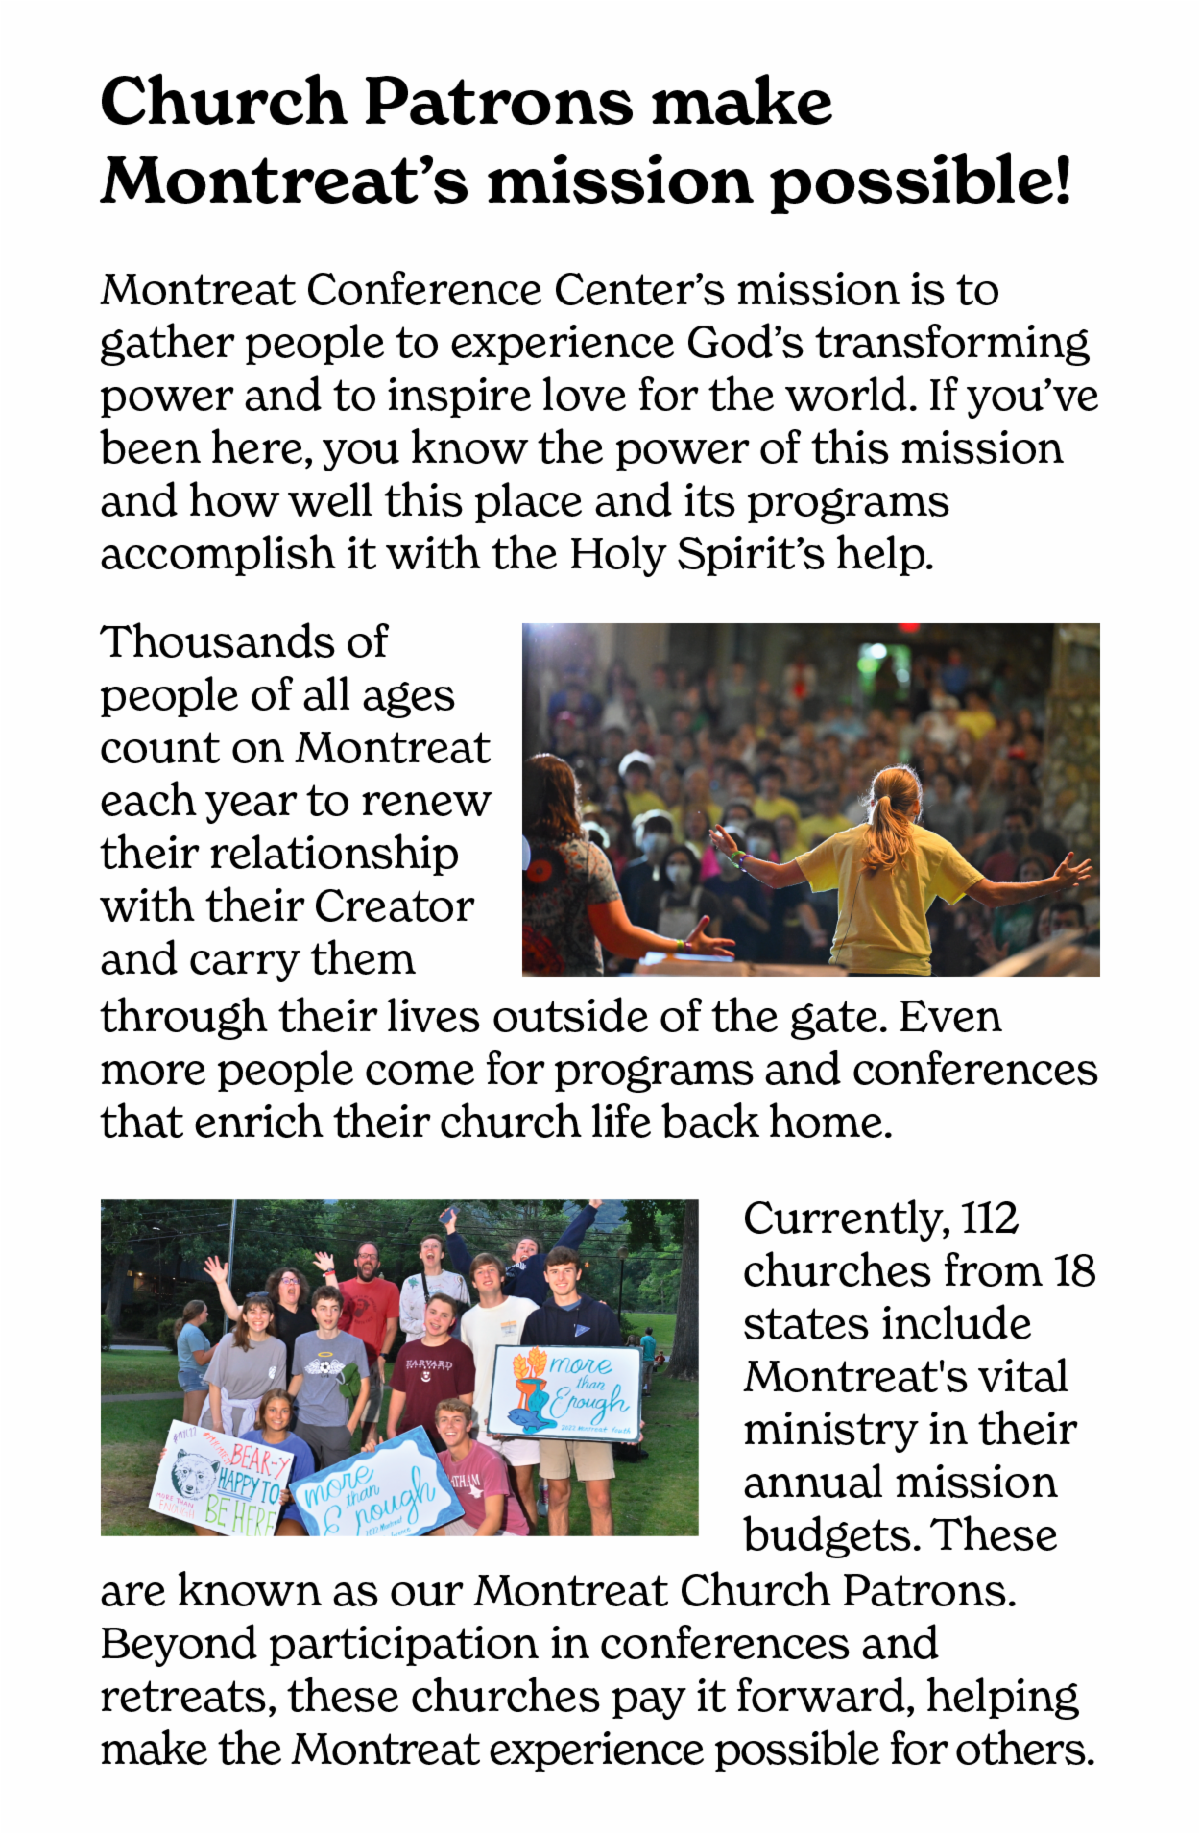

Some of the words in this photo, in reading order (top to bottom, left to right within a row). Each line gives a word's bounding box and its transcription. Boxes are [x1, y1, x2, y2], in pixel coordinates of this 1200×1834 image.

[101, 73, 349, 126] Church
[365, 75, 634, 126] Patrons
[651, 73, 833, 126] make
[99, 154, 469, 205] Montreat’s
[487, 153, 755, 205] mission
[769, 151, 1070, 215] possible!
[100, 273, 297, 306] Montreat
[307, 270, 542, 306] Conference
[555, 272, 725, 306] Center’s
[737, 271, 901, 306] mission
[911, 271, 945, 306] is
[955, 274, 999, 306] to
[100, 322, 235, 367] gather
[245, 323, 385, 366] people
[395, 326, 439, 359] to
[451, 324, 675, 366] experience
[687, 322, 804, 359] God’s
[814, 323, 1091, 367] transforming
[100, 386, 234, 419] power
[245, 374, 323, 412] and
[332, 379, 376, 412] to
[388, 376, 532, 419] inspire
[542, 375, 627, 412] love
[638, 375, 699, 412] for
[707, 374, 775, 412] the
[784, 374, 918, 412] world.
[929, 375, 959, 411] If
[966, 377, 1099, 420] you’ve
[99, 427, 202, 465] been
[211, 427, 313, 470] here,
[322, 439, 400, 472] you
[411, 427, 529, 465] know
[537, 427, 604, 465] the
[615, 439, 750, 472] power
[759, 428, 802, 465] of
[810, 427, 889, 465] this
[901, 429, 1065, 465] mission
[101, 480, 179, 518] and
[189, 480, 280, 518] how
[287, 481, 373, 518] well
[384, 480, 463, 518] this
[474, 481, 583, 524] place
[595, 480, 673, 518] and
[684, 482, 735, 518] its
[747, 487, 949, 525] programs
[101, 533, 336, 577] accomplish
[347, 535, 377, 570] it
[385, 533, 481, 570] with
[491, 534, 558, 570] the
[570, 534, 667, 578] Holy
[677, 535, 825, 577] Spirit’s
[836, 533, 933, 577] help.
[99, 621, 335, 659] Thousands
[347, 622, 390, 659] of
[100, 675, 239, 718] people
[251, 675, 294, 712] of
[303, 675, 350, 712] all
[363, 681, 455, 719] ages
[100, 732, 221, 764] count
[231, 738, 285, 764] on
[295, 731, 492, 764] Montreat
[101, 780, 197, 817] each
[204, 791, 298, 825] year
[305, 784, 349, 817] to
[362, 791, 493, 817] renew
[99, 832, 200, 870] their
[210, 832, 459, 877] relationship
[99, 885, 195, 923] with
[204, 885, 305, 923] their
[315, 888, 475, 923] Creator
[101, 938, 179, 976] and
[189, 950, 301, 983] carry
[310, 938, 417, 976] them
[99, 996, 268, 1041] through
[277, 996, 378, 1033] their
[387, 997, 480, 1033] lives
[492, 996, 649, 1033] outside
[659, 997, 703, 1033] of
[710, 996, 779, 1033] the
[790, 1000, 888, 1041] gate.
[899, 999, 1003, 1033] Even
[101, 1060, 206, 1086] more
[217, 1049, 354, 1093] people
[365, 1060, 475, 1086] come
[486, 1049, 545, 1086] for
[554, 1055, 754, 1094] programs
[765, 1049, 842, 1086] and
[852, 1049, 1098, 1086] conferences
[99, 1101, 184, 1139] that
[195, 1101, 324, 1139] enrich
[332, 1101, 431, 1139] their
[440, 1101, 582, 1139] church
[591, 1102, 652, 1139] life
[660, 1101, 760, 1139] back
[769, 1101, 893, 1139] home.
[744, 1198, 950, 1243] Currently,
[961, 1200, 1020, 1235] 112
[743, 1250, 931, 1288] churches
[944, 1251, 1044, 1288] from
[1054, 1253, 1096, 1288] 18
[743, 1308, 869, 1340] states
[882, 1303, 1032, 1340] include
[405, 1360, 453, 1371] HARVARD
[549, 1357, 613, 1375] more
[576, 1374, 605, 1390] than
[743, 1359, 968, 1393] Montreat's
[977, 1357, 1069, 1393] vital
[549, 1384, 631, 1426] Enough
[561, 1424, 577, 1432] 2022
[577, 1425, 608, 1433] Montreat
[611, 1426, 631, 1435] Youth
[744, 1411, 919, 1454] ministry
[929, 1411, 969, 1445] in
[977, 1409, 1078, 1446] their
[230, 1443, 291, 1480] BEAR-Y
[744, 1462, 883, 1499] annual
[896, 1463, 1059, 1499] mission
[155, 1491, 174, 1502] MORE
[177, 1497, 194, 1509] THAN
[218, 1467, 260, 1498] HAPPY
[261, 1480, 280, 1505] TO
[304, 1465, 374, 1509] more
[323, 1465, 436, 1536] Enough
[345, 1484, 380, 1509] than
[158, 1499, 196, 1519] ENOUGH
[205, 1493, 230, 1527] BE
[232, 1500, 277, 1536] HERE
[742, 1514, 922, 1559] budgets.
[929, 1514, 1058, 1552] These
[101, 1581, 166, 1607] are
[178, 1570, 323, 1607] known
[333, 1581, 378, 1607] as
[390, 1581, 464, 1607] our
[473, 1574, 669, 1607] Montreat
[681, 1570, 831, 1607] Church
[843, 1573, 1017, 1607] Patrons.
[101, 1624, 258, 1668] Beyond
[269, 1625, 540, 1667] participation
[551, 1625, 590, 1659] in
[600, 1624, 850, 1660] conferences
[862, 1623, 940, 1660] and
[101, 1680, 277, 1718] retreats,
[286, 1676, 399, 1713] these
[411, 1676, 600, 1713] churches
[611, 1687, 686, 1721] pay
[697, 1677, 727, 1713] it
[736, 1676, 915, 1718] forward,
[926, 1676, 1080, 1721] helping
[101, 1728, 208, 1766] make
[217, 1728, 282, 1766] the
[291, 1732, 481, 1766] Montreat
[490, 1730, 705, 1773] experience
[714, 1729, 880, 1773] possible
[890, 1729, 949, 1766] for
[955, 1728, 1095, 1766] others.
